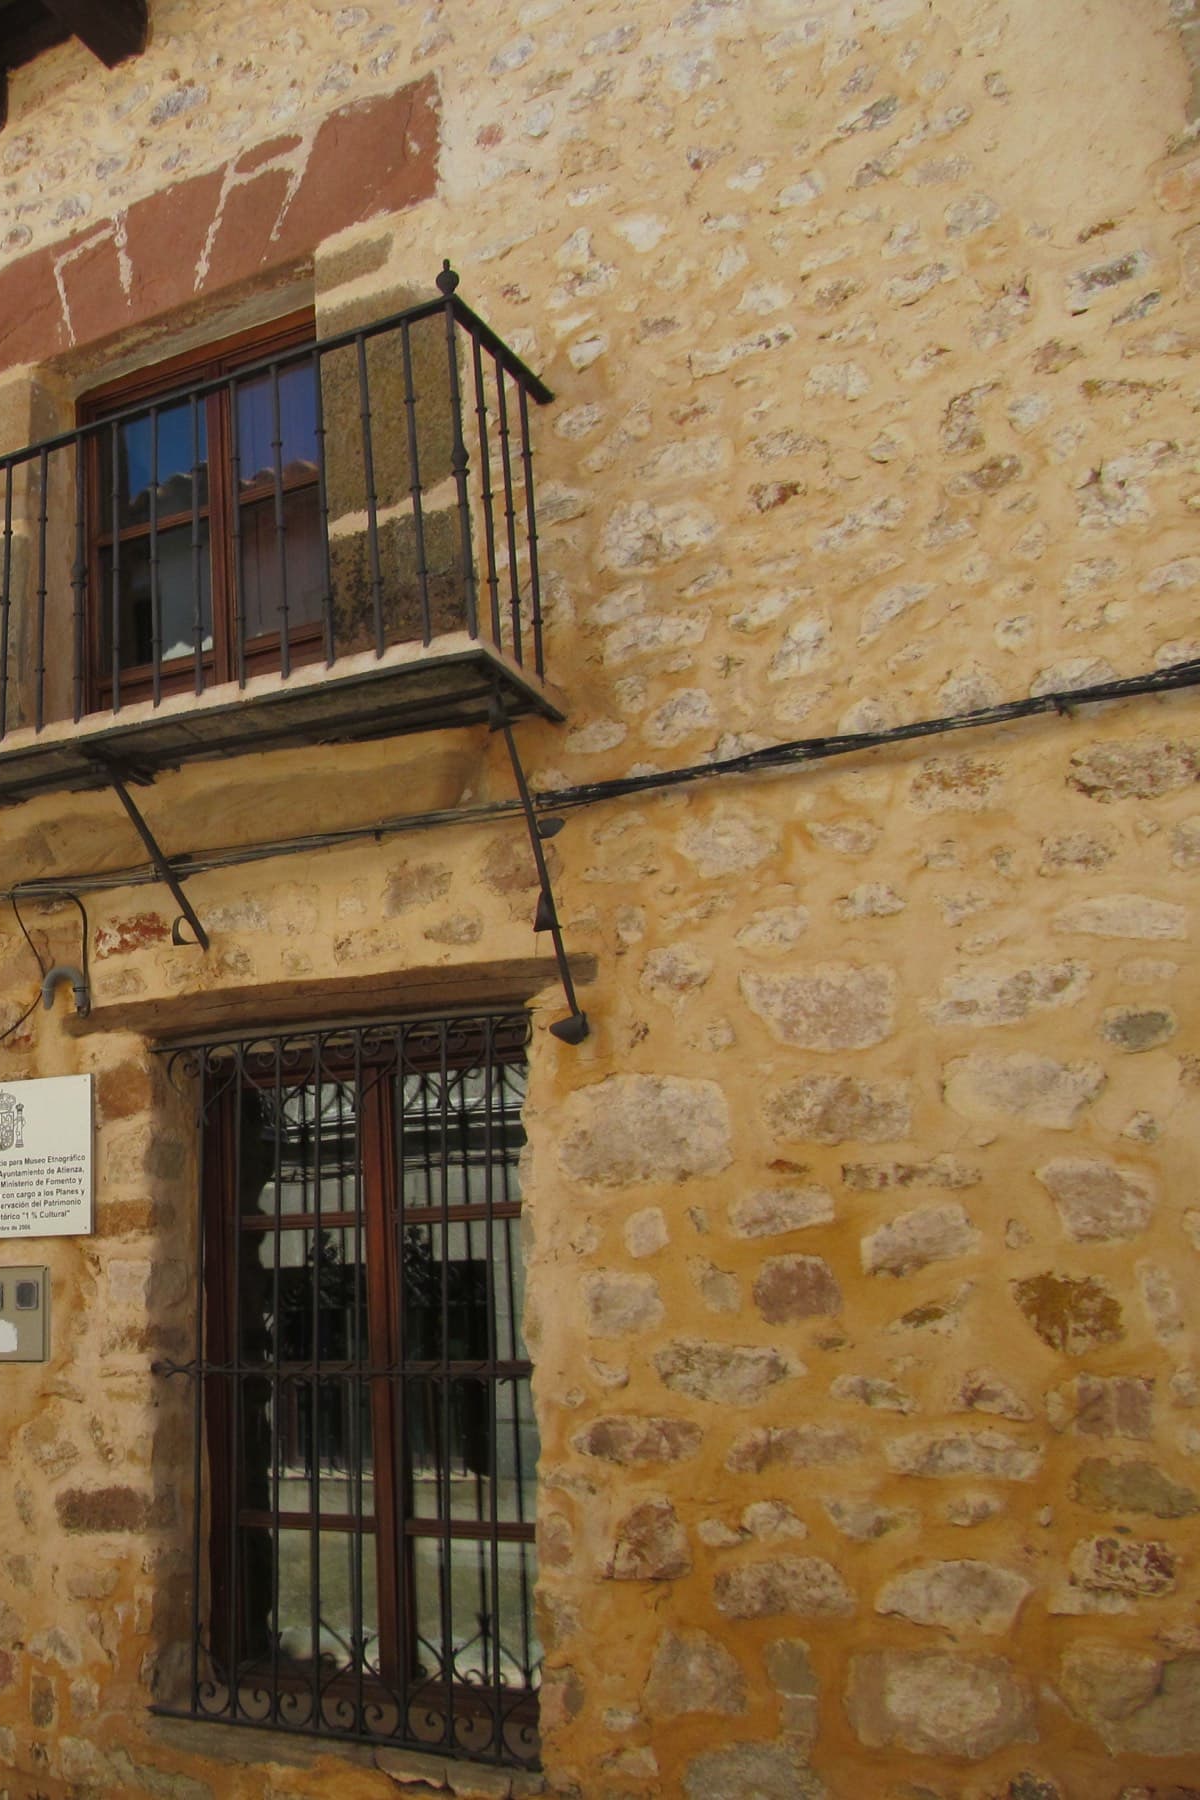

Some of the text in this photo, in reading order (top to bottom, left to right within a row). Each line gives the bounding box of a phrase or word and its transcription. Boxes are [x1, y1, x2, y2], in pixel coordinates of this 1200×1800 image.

[9, 1159, 22, 1167] para
[47, 1154, 86, 1164] Etnográfico
[56, 1166, 84, 1174] Atienza,
[0, 1180, 34, 1188] Ministerio
[46, 1177, 77, 1185] Fomento
[16, 1191, 36, 1199] cargo
[31, 1200, 42, 1208] del
[43, 1198, 82, 1207] Patrimonio
[31, 1211, 37, 1219] %
